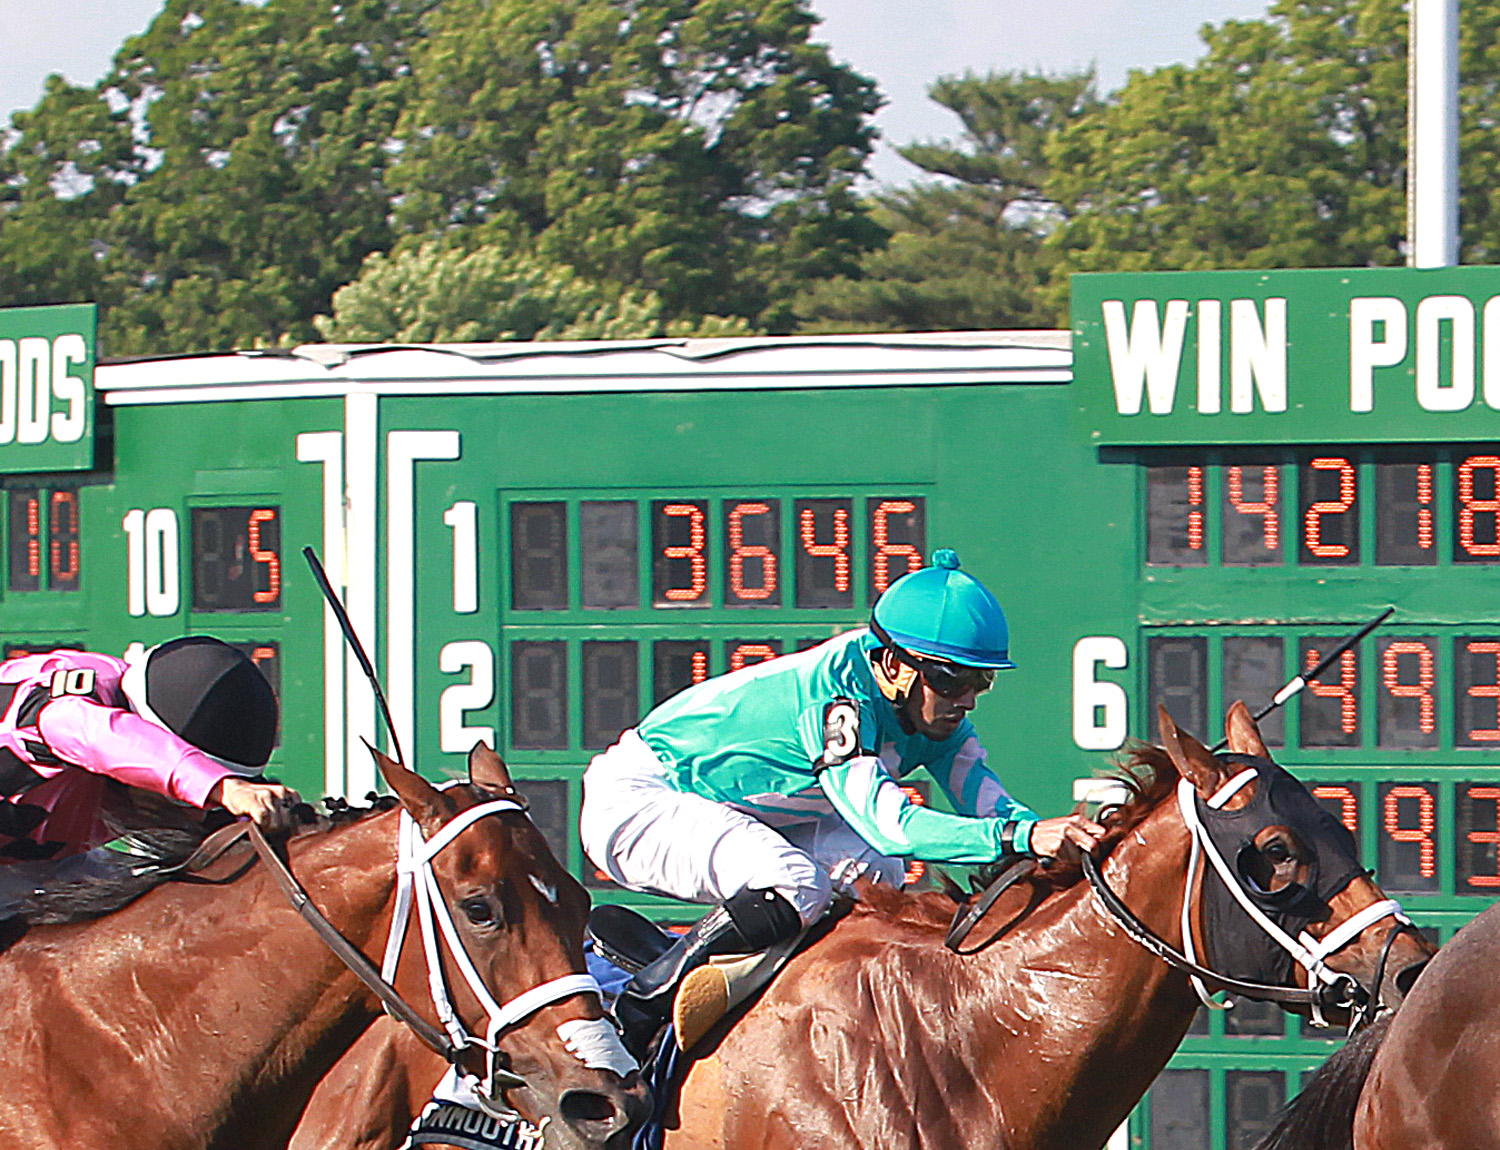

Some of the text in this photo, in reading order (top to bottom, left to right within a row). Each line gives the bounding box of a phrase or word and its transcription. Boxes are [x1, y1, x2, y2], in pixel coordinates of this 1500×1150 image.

[1102, 298, 1288, 415] WIN
[122, 508, 180, 617] 10
[443, 501, 479, 614] 1
[662, 501, 922, 601] 3646
[51, 669, 96, 698] 10
[440, 641, 496, 753] 2
[827, 704, 858, 757] 3
[1072, 636, 1128, 750] 6
